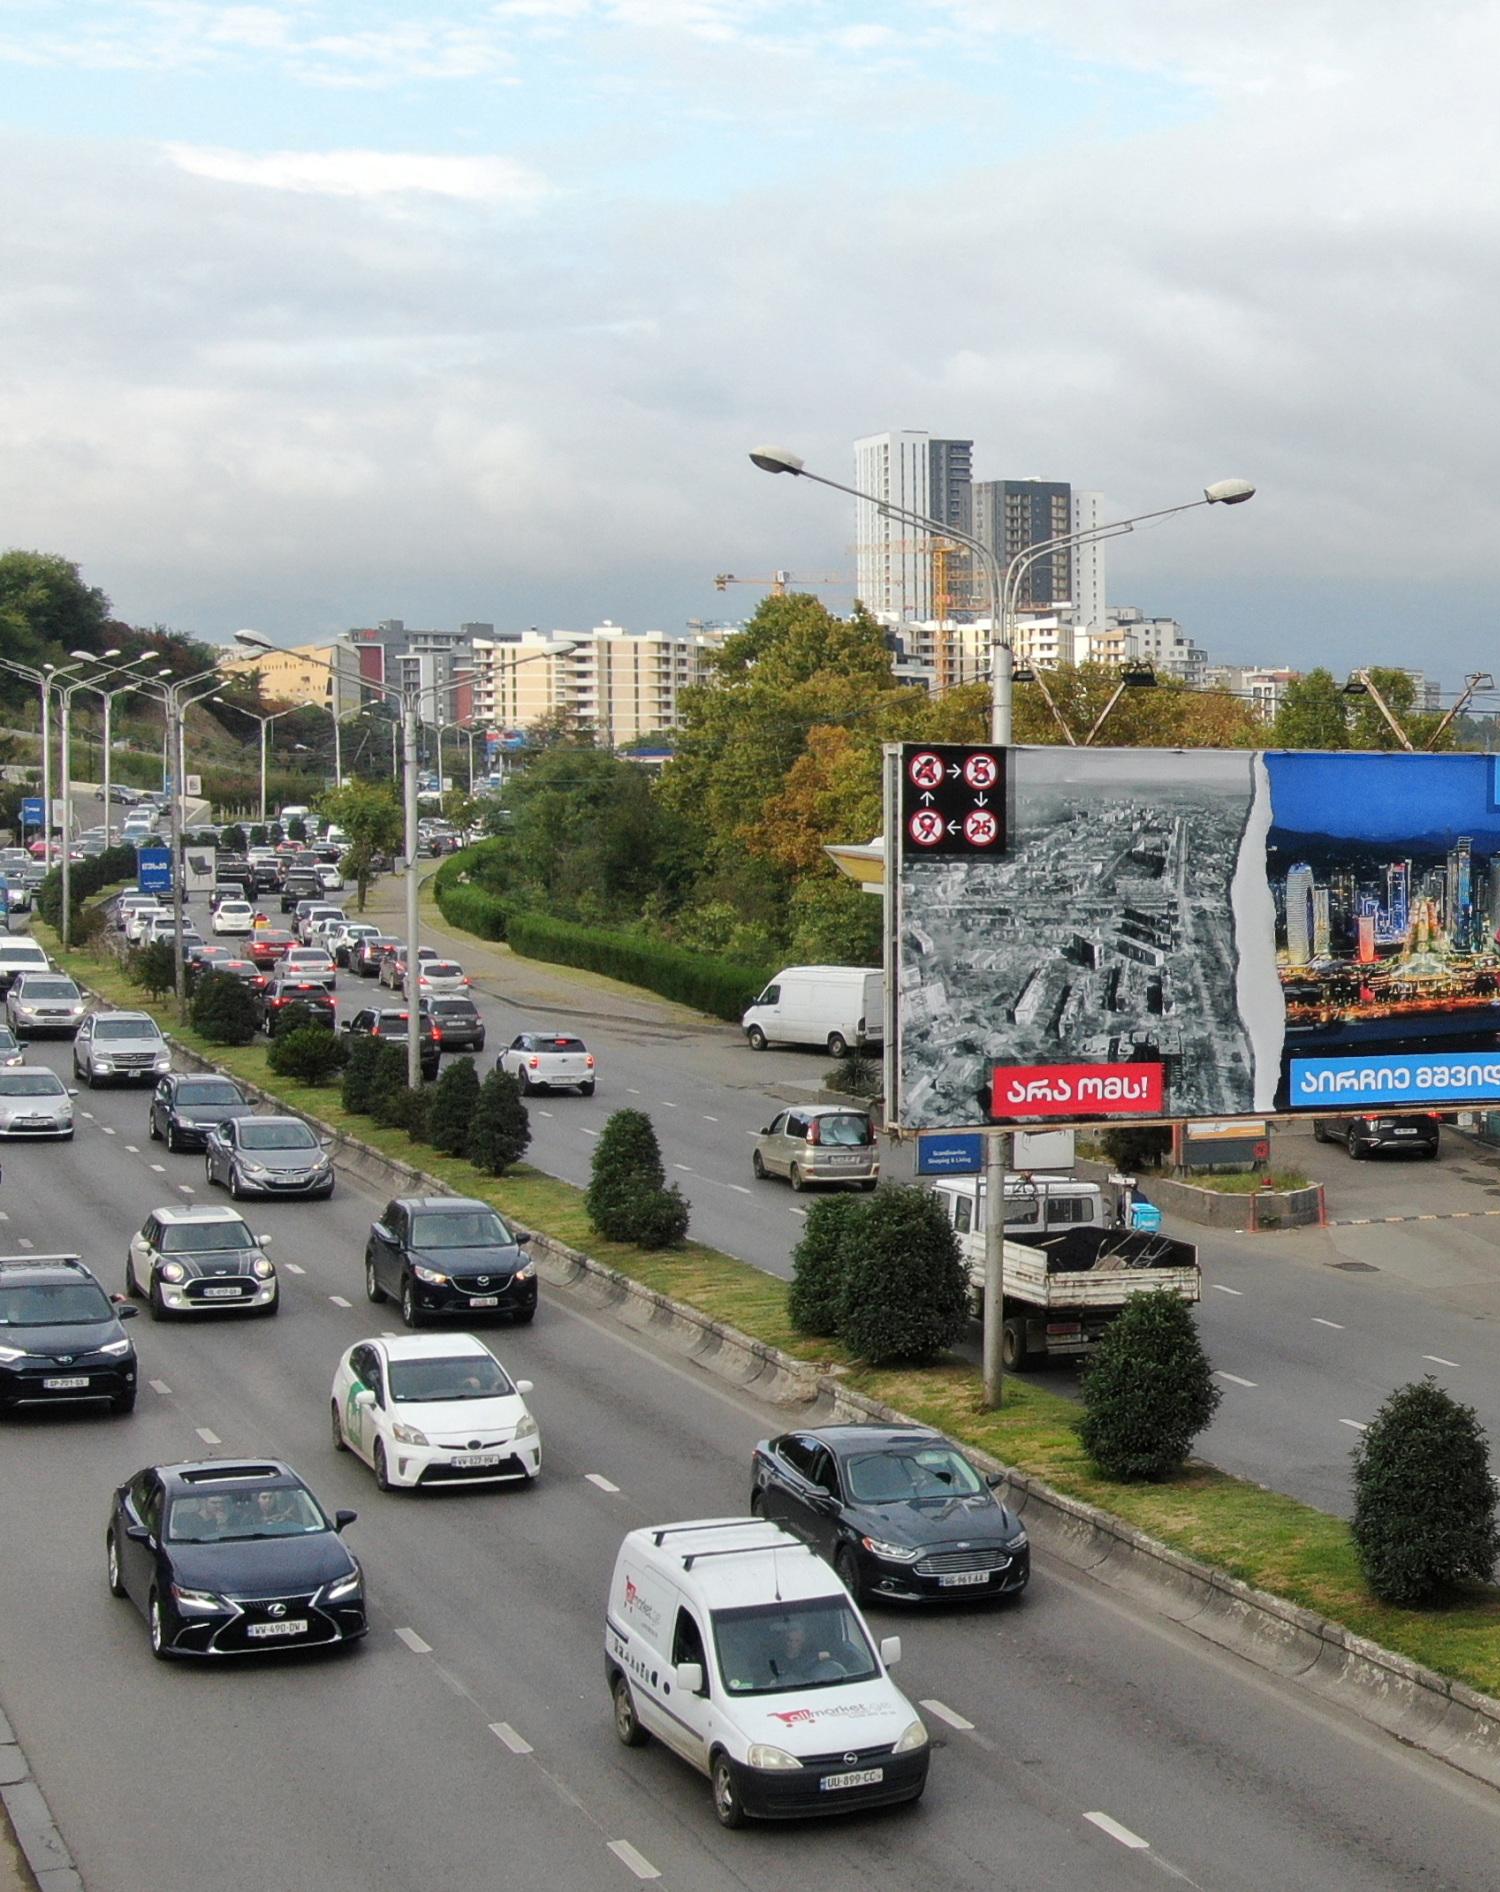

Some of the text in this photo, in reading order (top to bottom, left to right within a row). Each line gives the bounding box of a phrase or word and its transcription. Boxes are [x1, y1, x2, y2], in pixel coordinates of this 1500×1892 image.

[974, 758, 990, 784] 5
[1007, 1076, 1148, 1103] არა ომს!
[1301, 1067, 1410, 1092] აირჩიე
[827, 1771, 876, 1788] UU-899-CC
